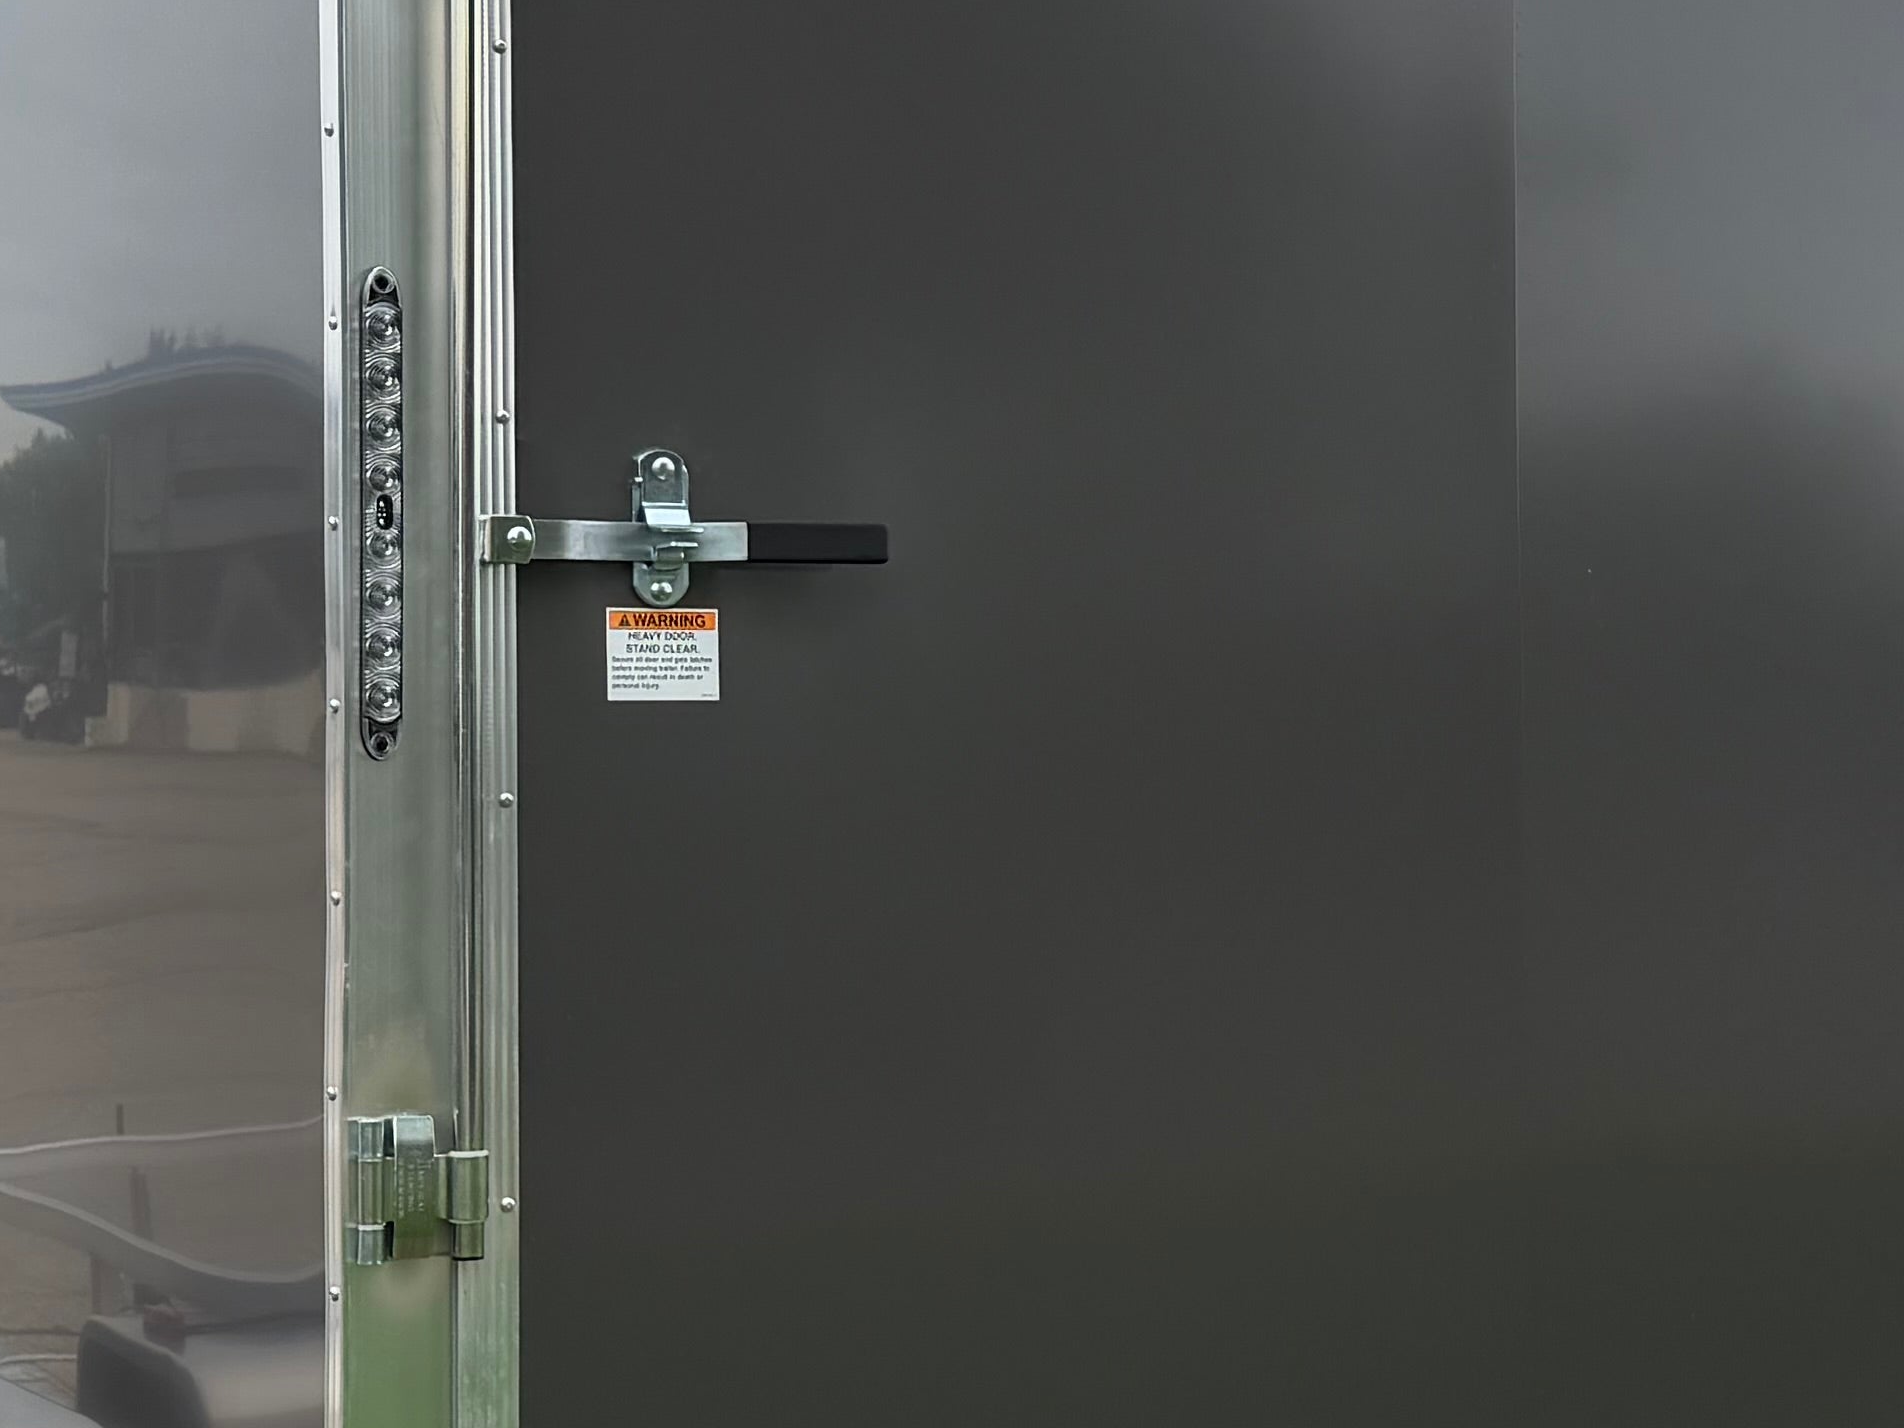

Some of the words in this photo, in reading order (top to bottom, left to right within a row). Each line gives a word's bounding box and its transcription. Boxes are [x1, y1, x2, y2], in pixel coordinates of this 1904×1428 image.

[633, 614, 706, 628] WARNING
[628, 632, 662, 641] HEAVY
[626, 644, 660, 653] STAND
